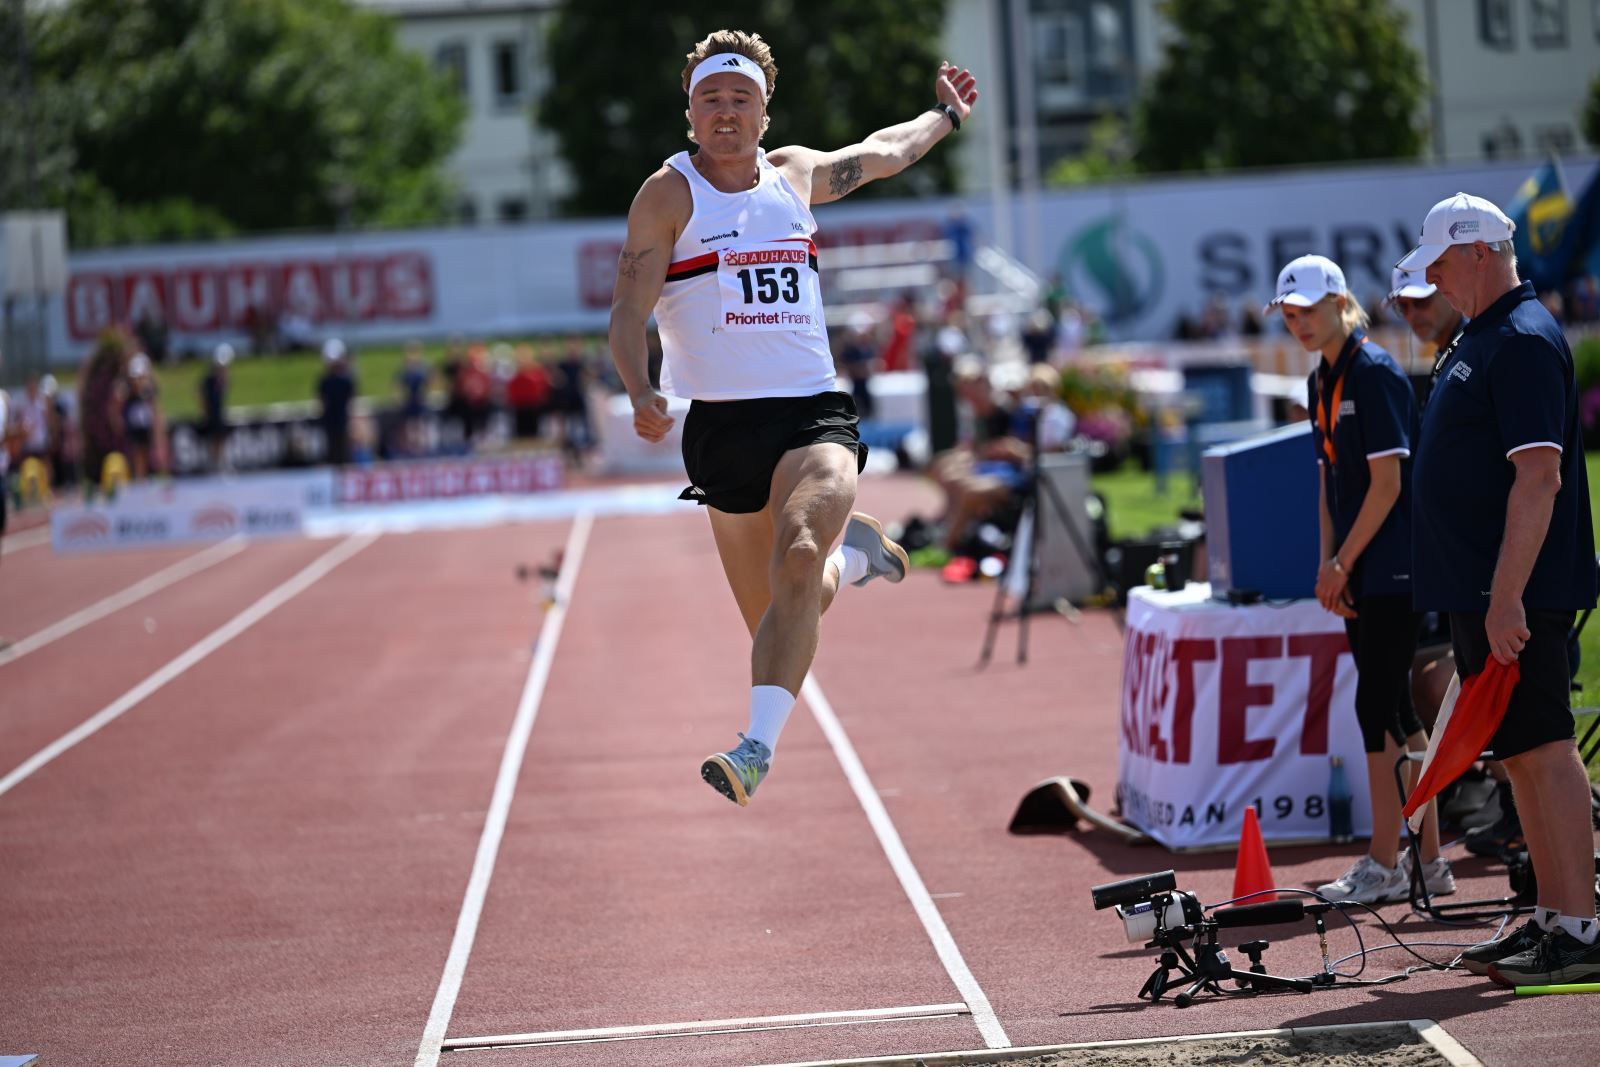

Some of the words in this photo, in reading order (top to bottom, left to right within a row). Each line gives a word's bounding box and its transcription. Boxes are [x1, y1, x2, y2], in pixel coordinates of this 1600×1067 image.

[739, 251, 805, 264] BAUHAUS
[737, 267, 800, 304] 153
[725, 312, 780, 325] Prioritet
[781, 311, 811, 324] Finans
[1253, 795, 1326, 820] 198
